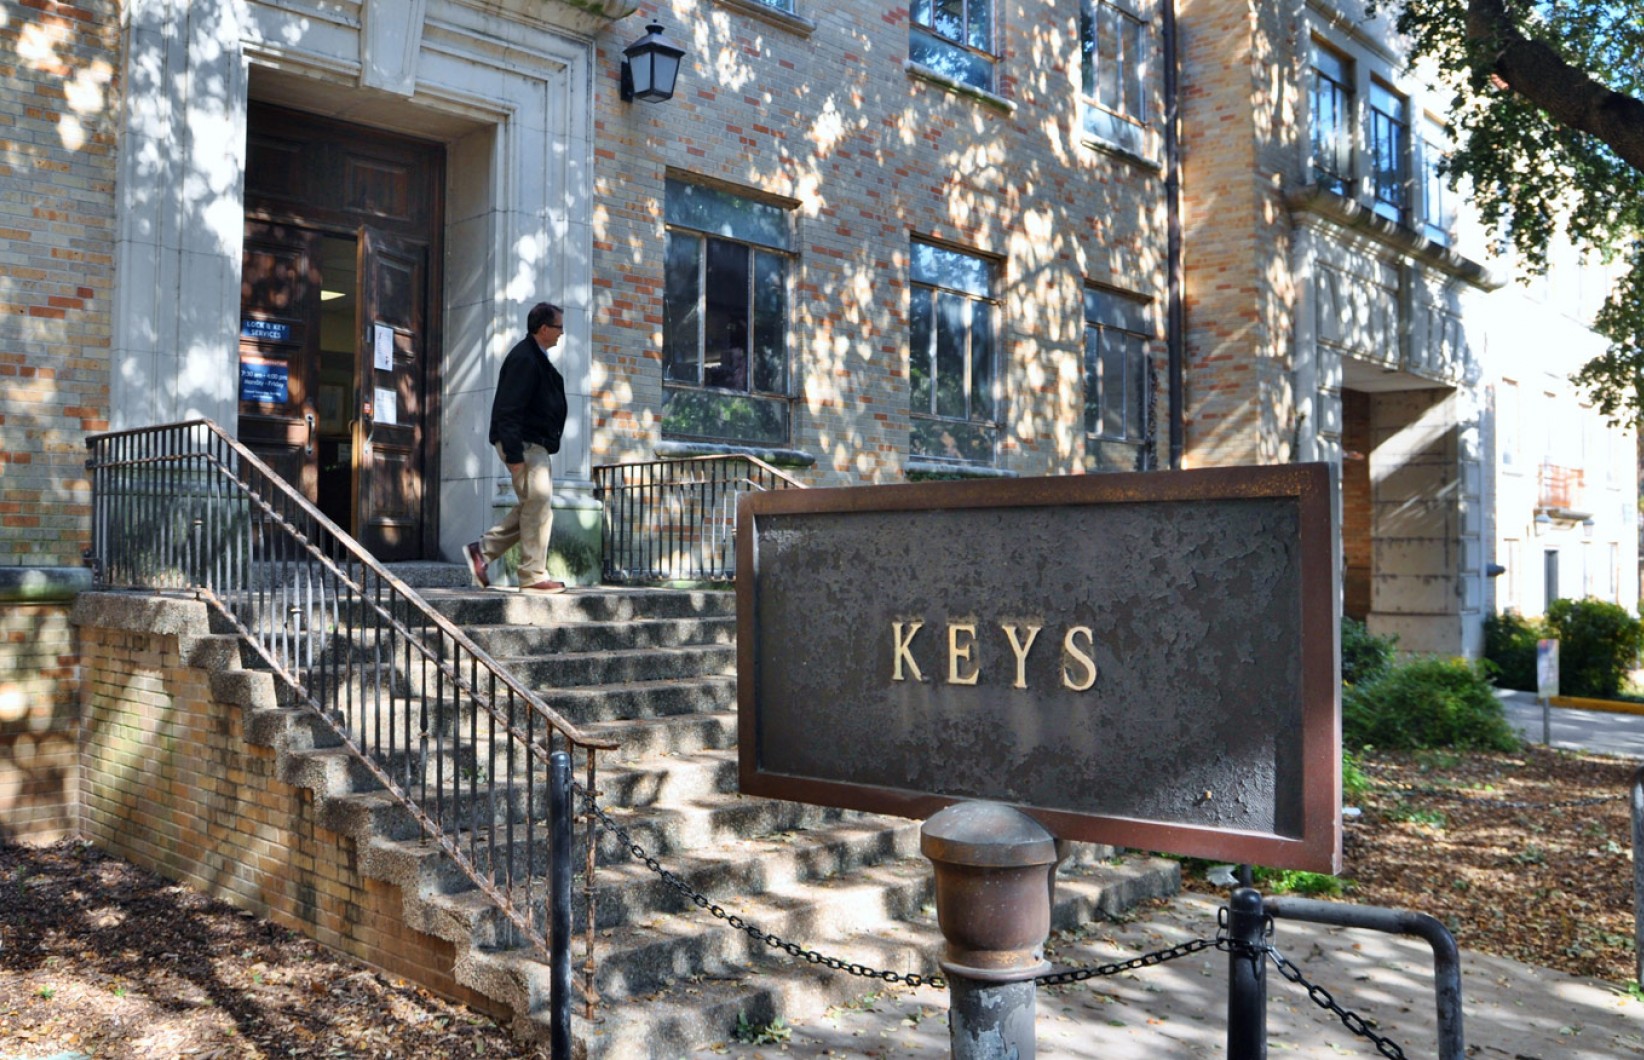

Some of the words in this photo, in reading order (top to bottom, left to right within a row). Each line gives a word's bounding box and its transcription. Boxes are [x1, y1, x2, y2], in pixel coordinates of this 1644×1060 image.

[246, 321, 265, 329] LOCK
[273, 323, 286, 331] KEY
[251, 329, 281, 339] SERVICES
[244, 379, 264, 387] Monday
[268, 381, 284, 390] Friday
[892, 622, 1097, 691] KEYS
